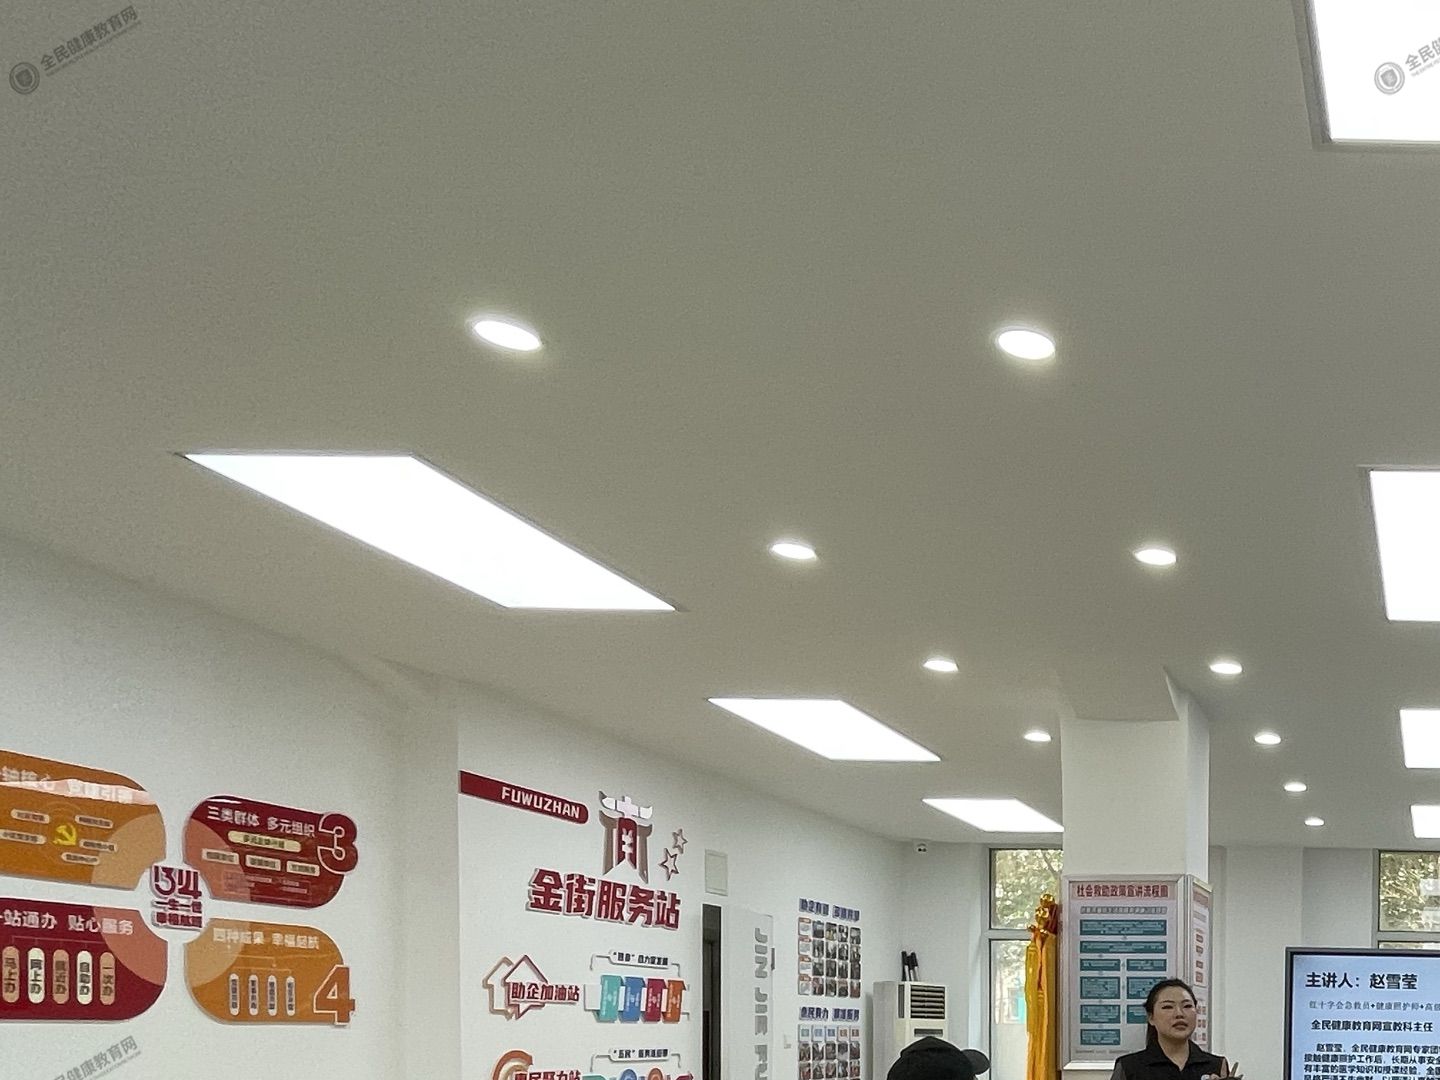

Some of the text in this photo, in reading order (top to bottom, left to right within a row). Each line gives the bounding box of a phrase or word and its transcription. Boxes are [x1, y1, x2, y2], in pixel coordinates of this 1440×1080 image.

[501, 786, 581, 821] FUWUZHAN
[207, 805, 316, 838] 三类群体 多元组织
[528, 867, 681, 930] 金街服务站
[0, 909, 134, 936] 站通办 贴心服务
[754, 928, 769, 979] JIN
[510, 980, 581, 1005] 助企加油站
[754, 987, 769, 1036] JIE
[1310, 1018, 1434, 1033] 全民健康教育网宣教科主任
